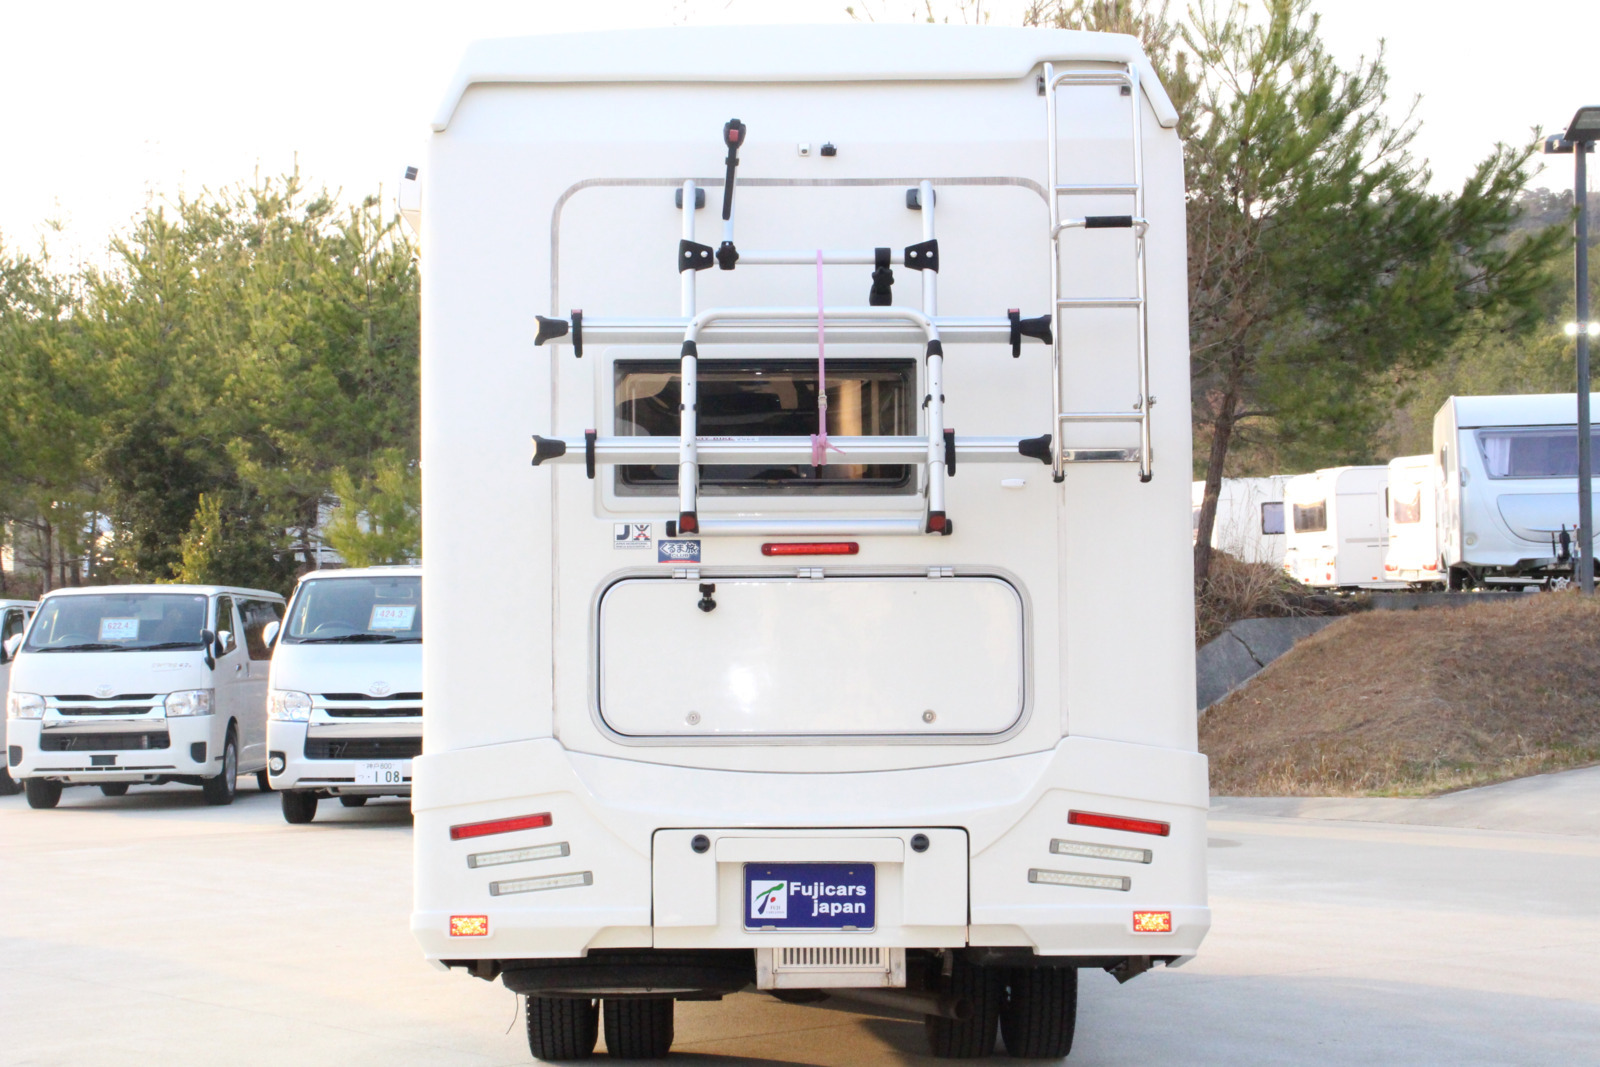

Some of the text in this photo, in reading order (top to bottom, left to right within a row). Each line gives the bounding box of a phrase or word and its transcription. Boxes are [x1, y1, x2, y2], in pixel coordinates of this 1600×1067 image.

[660, 543, 699, 555] くるま旅
[790, 882, 867, 899] Fujicars
[811, 900, 866, 917] japan
